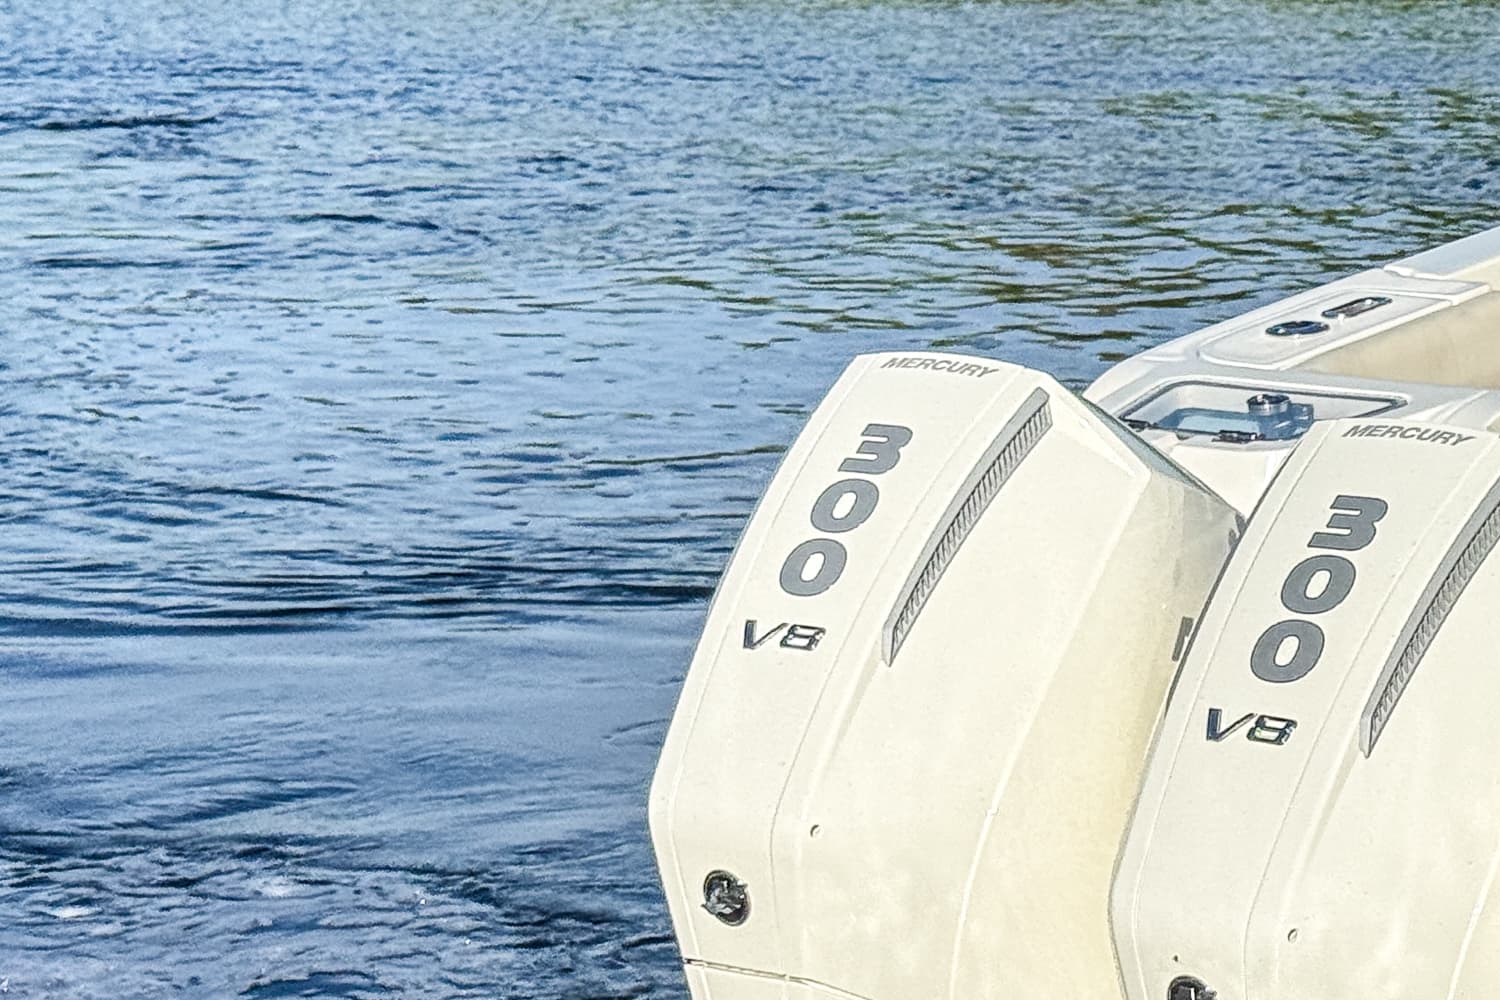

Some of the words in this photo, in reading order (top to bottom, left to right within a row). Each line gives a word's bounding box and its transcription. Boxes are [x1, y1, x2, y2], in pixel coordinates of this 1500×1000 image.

[881, 357, 1000, 378] MERCURY
[1341, 424, 1477, 446] MERCURY
[779, 423, 913, 597] 300
[1250, 495, 1388, 683] 300
[743, 620, 826, 651] V8
[1206, 708, 1298, 745] V8
